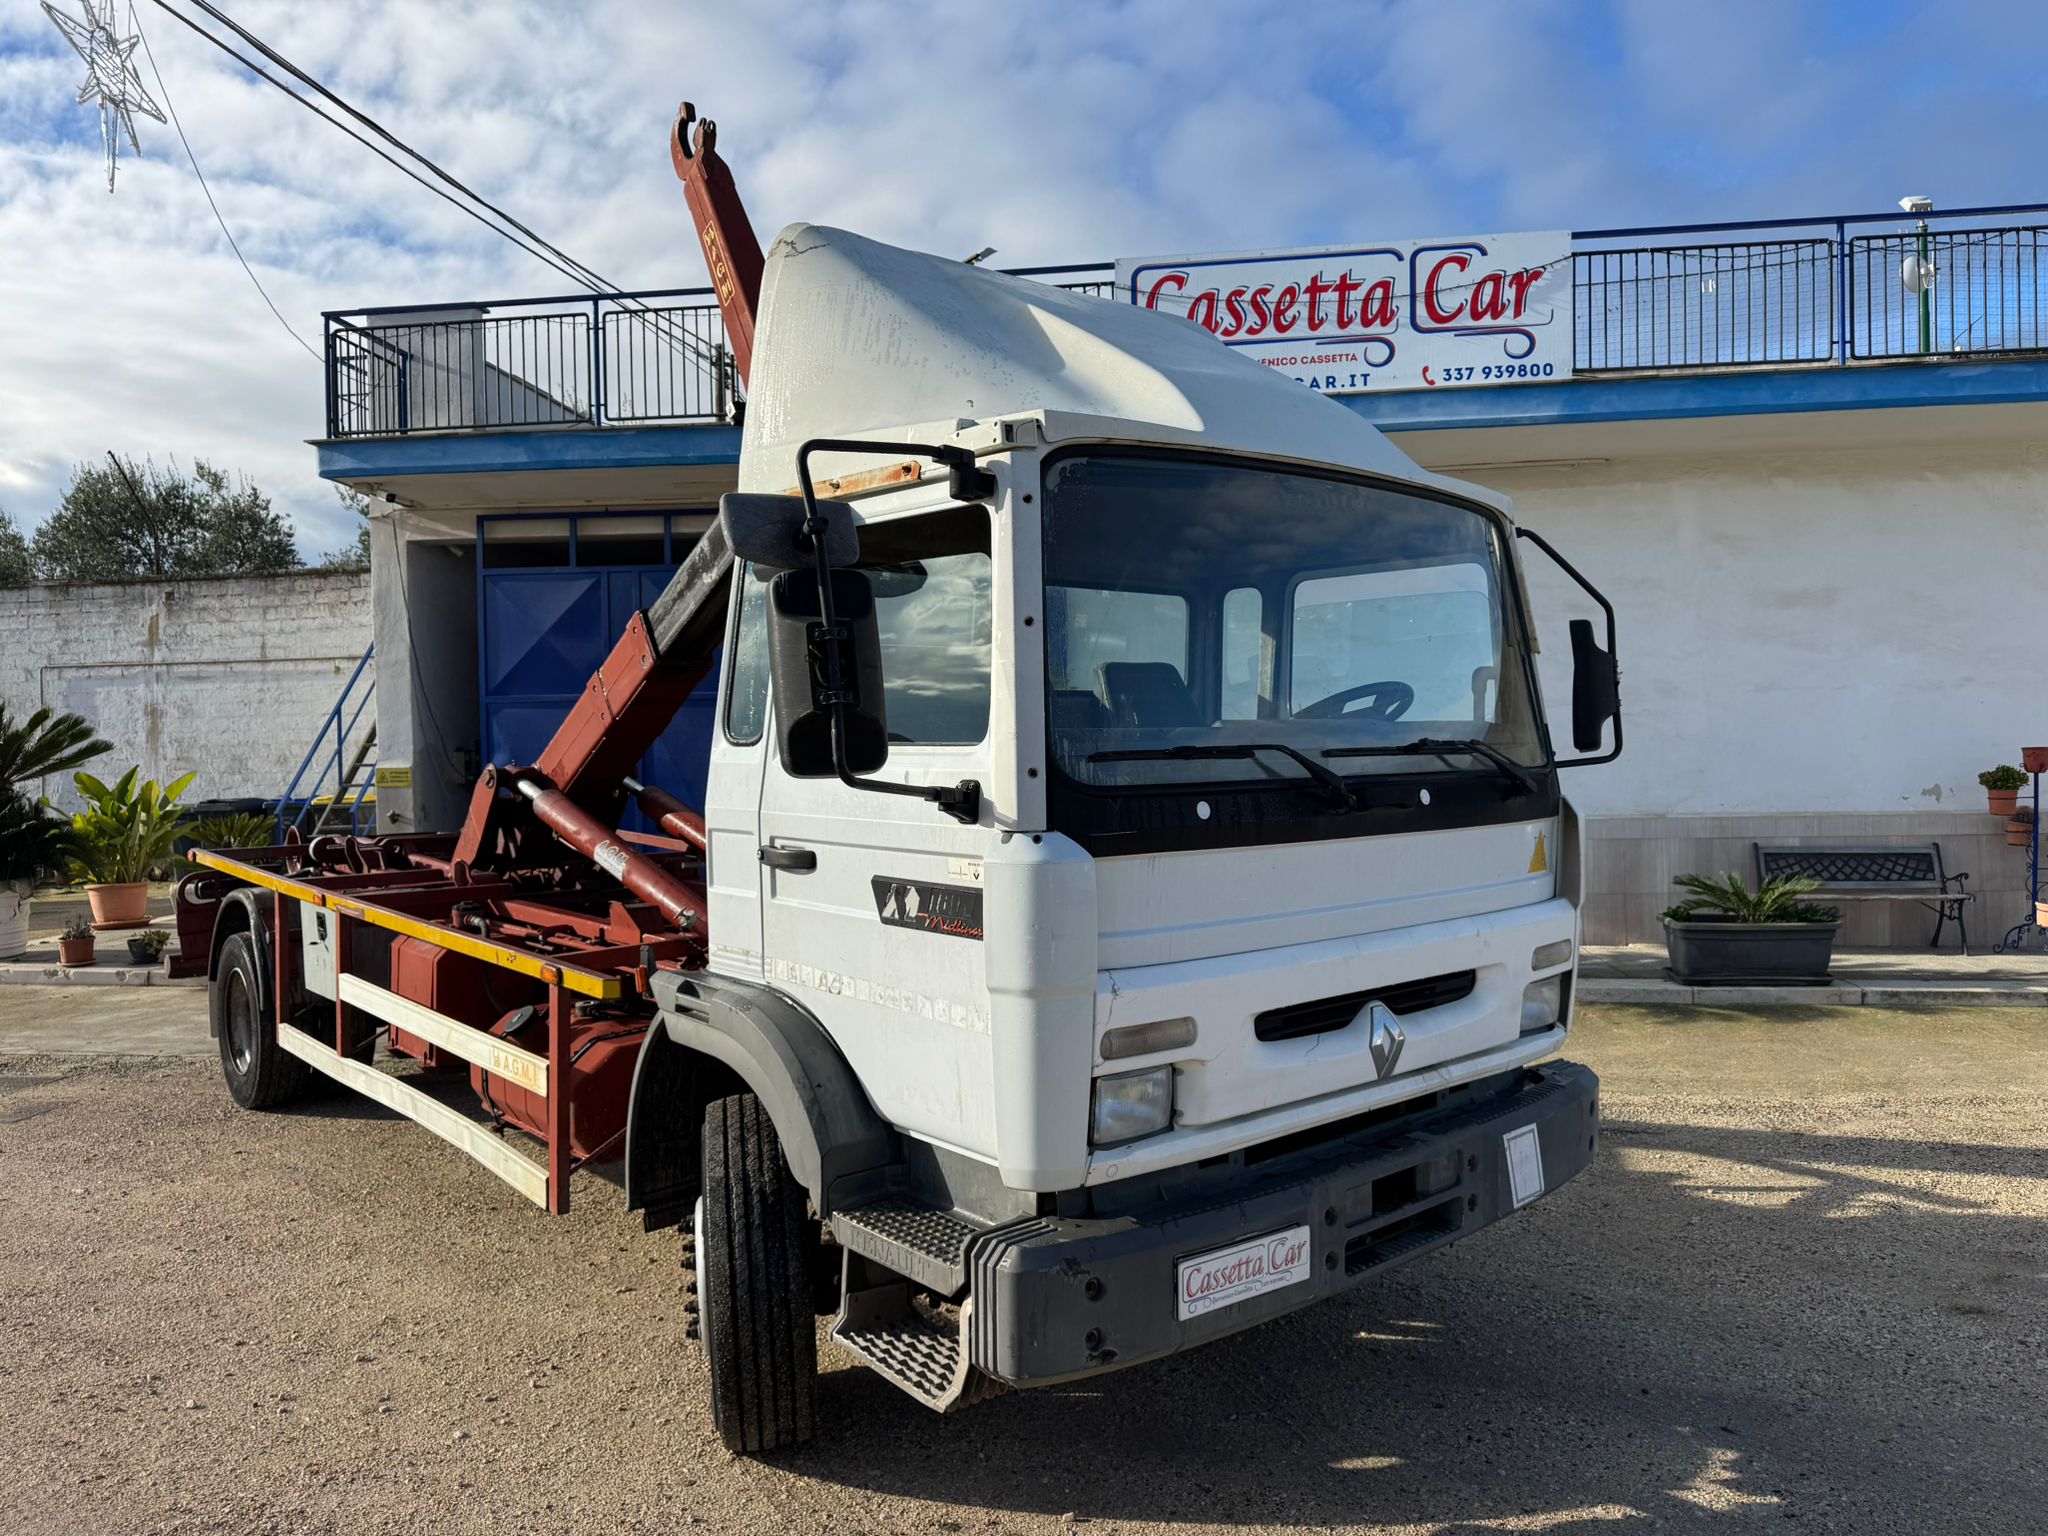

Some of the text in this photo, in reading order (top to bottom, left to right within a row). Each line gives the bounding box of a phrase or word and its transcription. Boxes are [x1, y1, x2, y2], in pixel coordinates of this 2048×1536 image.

[1146, 252, 1547, 337] Cassetta Car
[1258, 353, 1358, 367] ENICO CASSETTA
[1443, 362, 1554, 382] 337 939800
[850, 1226, 932, 1280] RENAULT
[1186, 1255, 1264, 1298] Cassetta
[1271, 1240, 1307, 1271] Car
